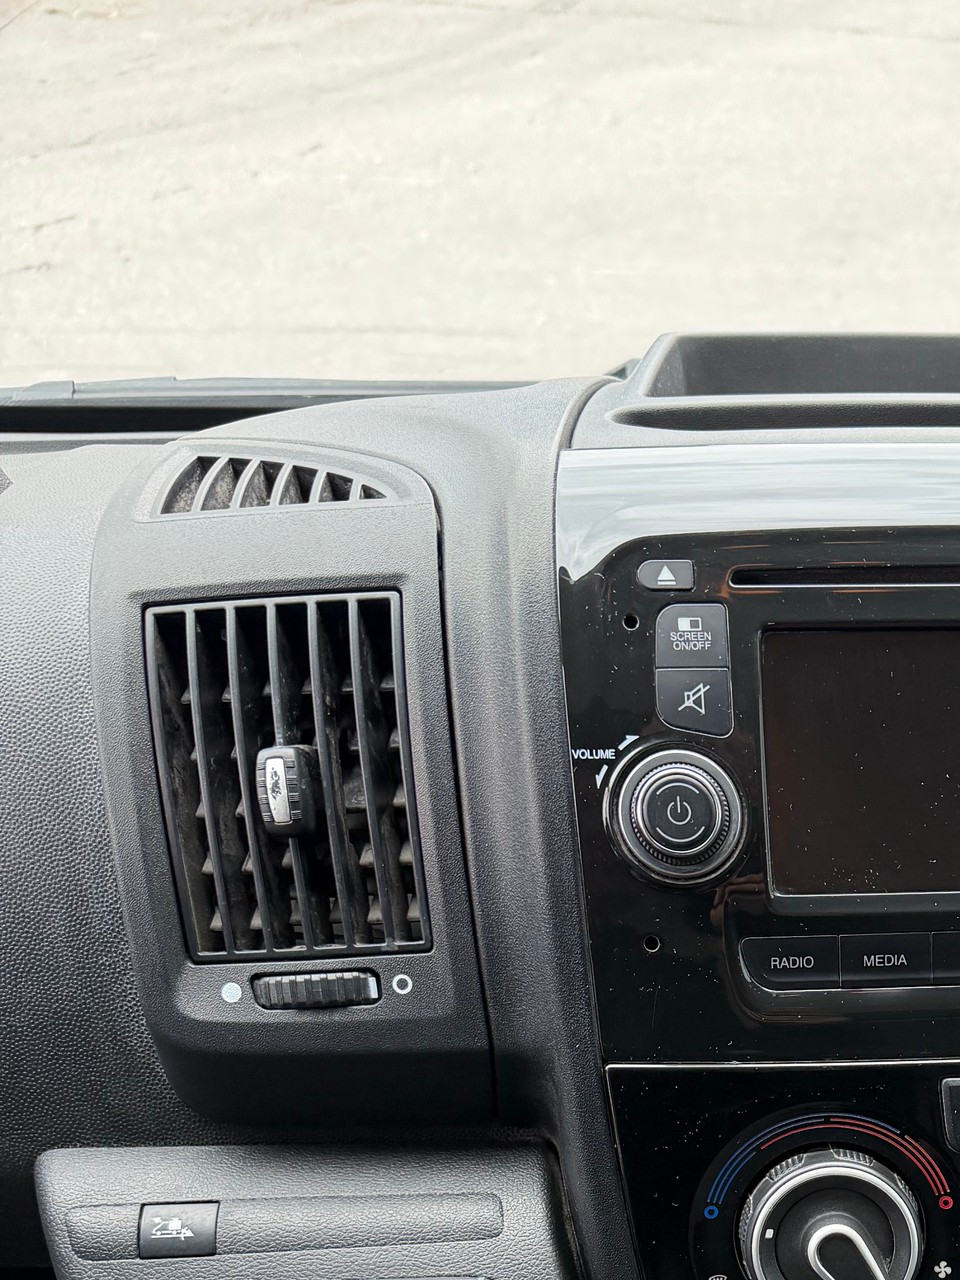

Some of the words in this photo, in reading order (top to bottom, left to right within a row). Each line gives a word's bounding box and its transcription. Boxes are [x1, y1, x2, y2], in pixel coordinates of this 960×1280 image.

[669, 629, 712, 642] SCREEN
[672, 640, 712, 651] ON/OFF
[571, 748, 616, 760] VOLUME
[770, 955, 814, 969] RADIO
[863, 954, 908, 967] MEDIA
